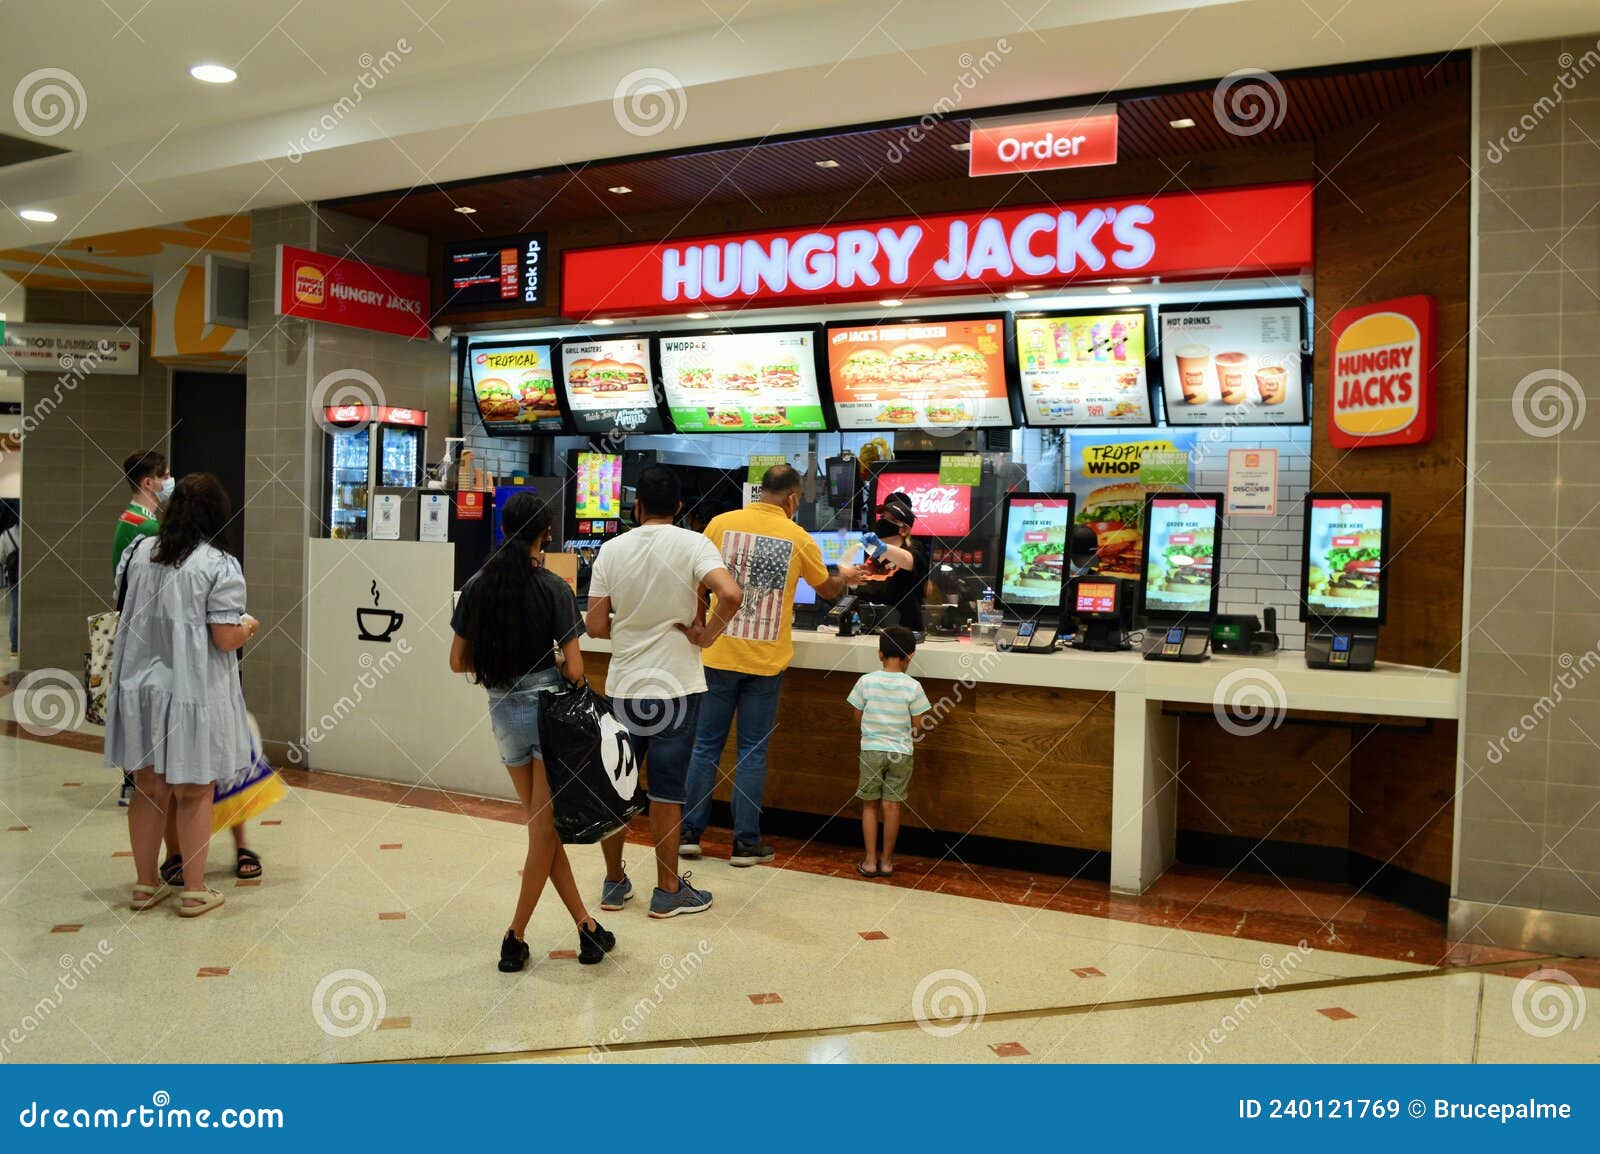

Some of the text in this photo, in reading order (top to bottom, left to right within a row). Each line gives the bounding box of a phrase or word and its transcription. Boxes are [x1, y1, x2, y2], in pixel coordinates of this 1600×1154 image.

[998, 132, 1086, 162] Order
[662, 204, 1156, 301] HUNGRY JACK'S
[525, 240, 541, 302] Pick Up
[330, 283, 384, 306] HUNGRY
[1167, 316, 1211, 326] HOT DRINKS
[488, 353, 536, 368] TROPICAL
[580, 345, 602, 354] MASTERS
[1337, 345, 1413, 410] HUNGRY JACK'S
[1092, 444, 1166, 461] TROPI
